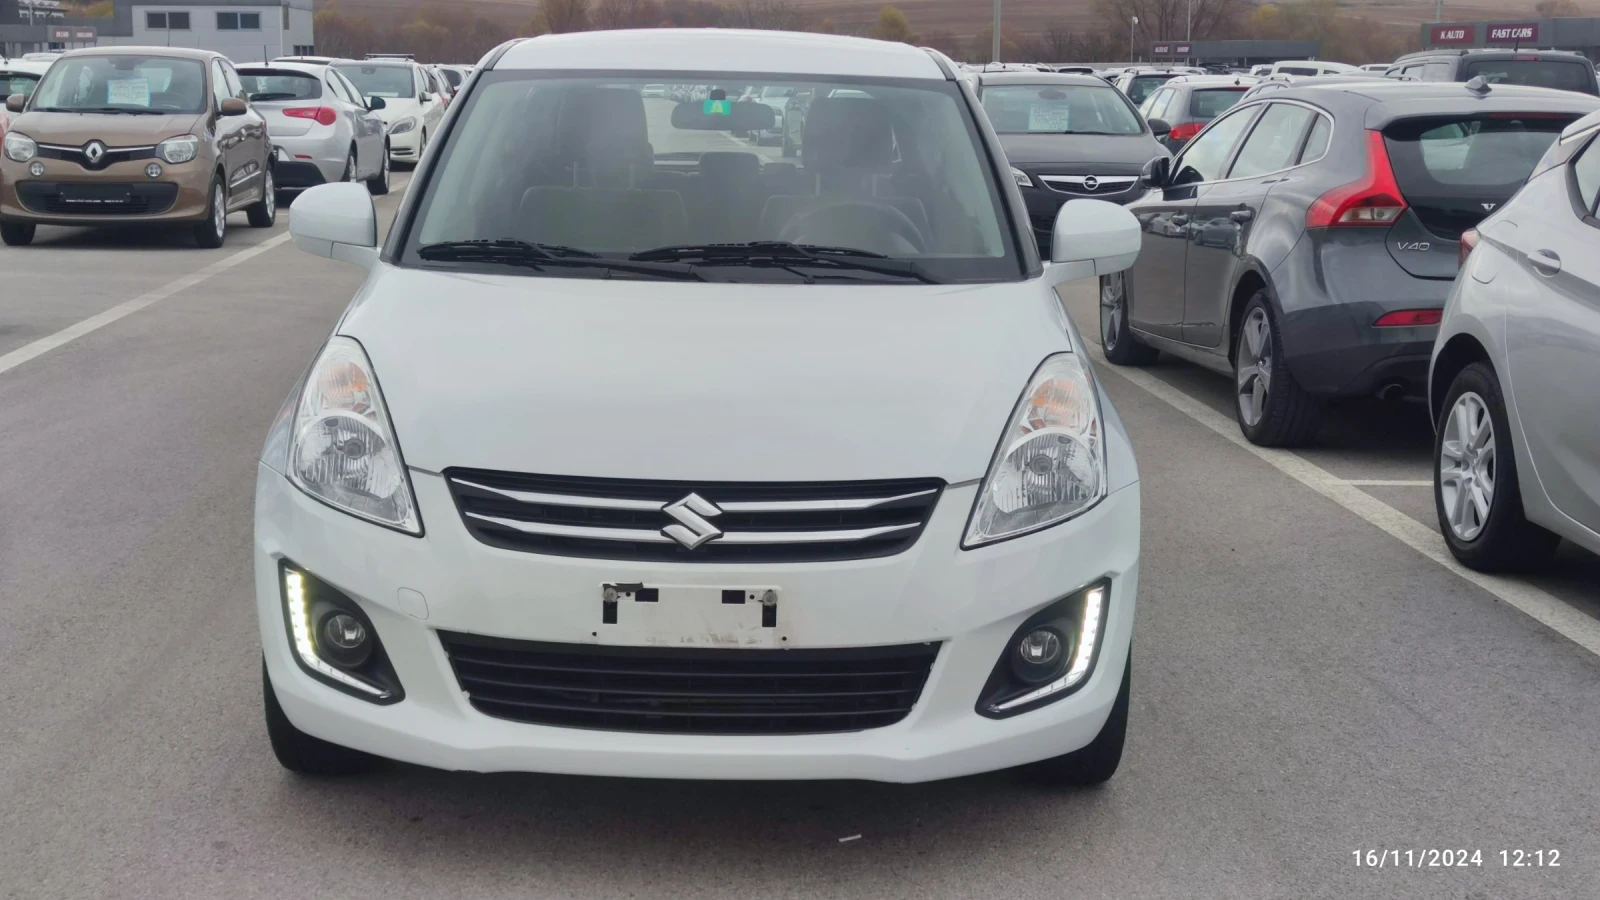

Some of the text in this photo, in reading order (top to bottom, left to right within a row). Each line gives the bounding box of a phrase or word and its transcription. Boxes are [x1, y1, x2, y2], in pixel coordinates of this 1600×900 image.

[1440, 30, 1465, 40] K AUTO
[1492, 28, 1533, 38] FAST CARS
[1397, 242, 1430, 251] V40
